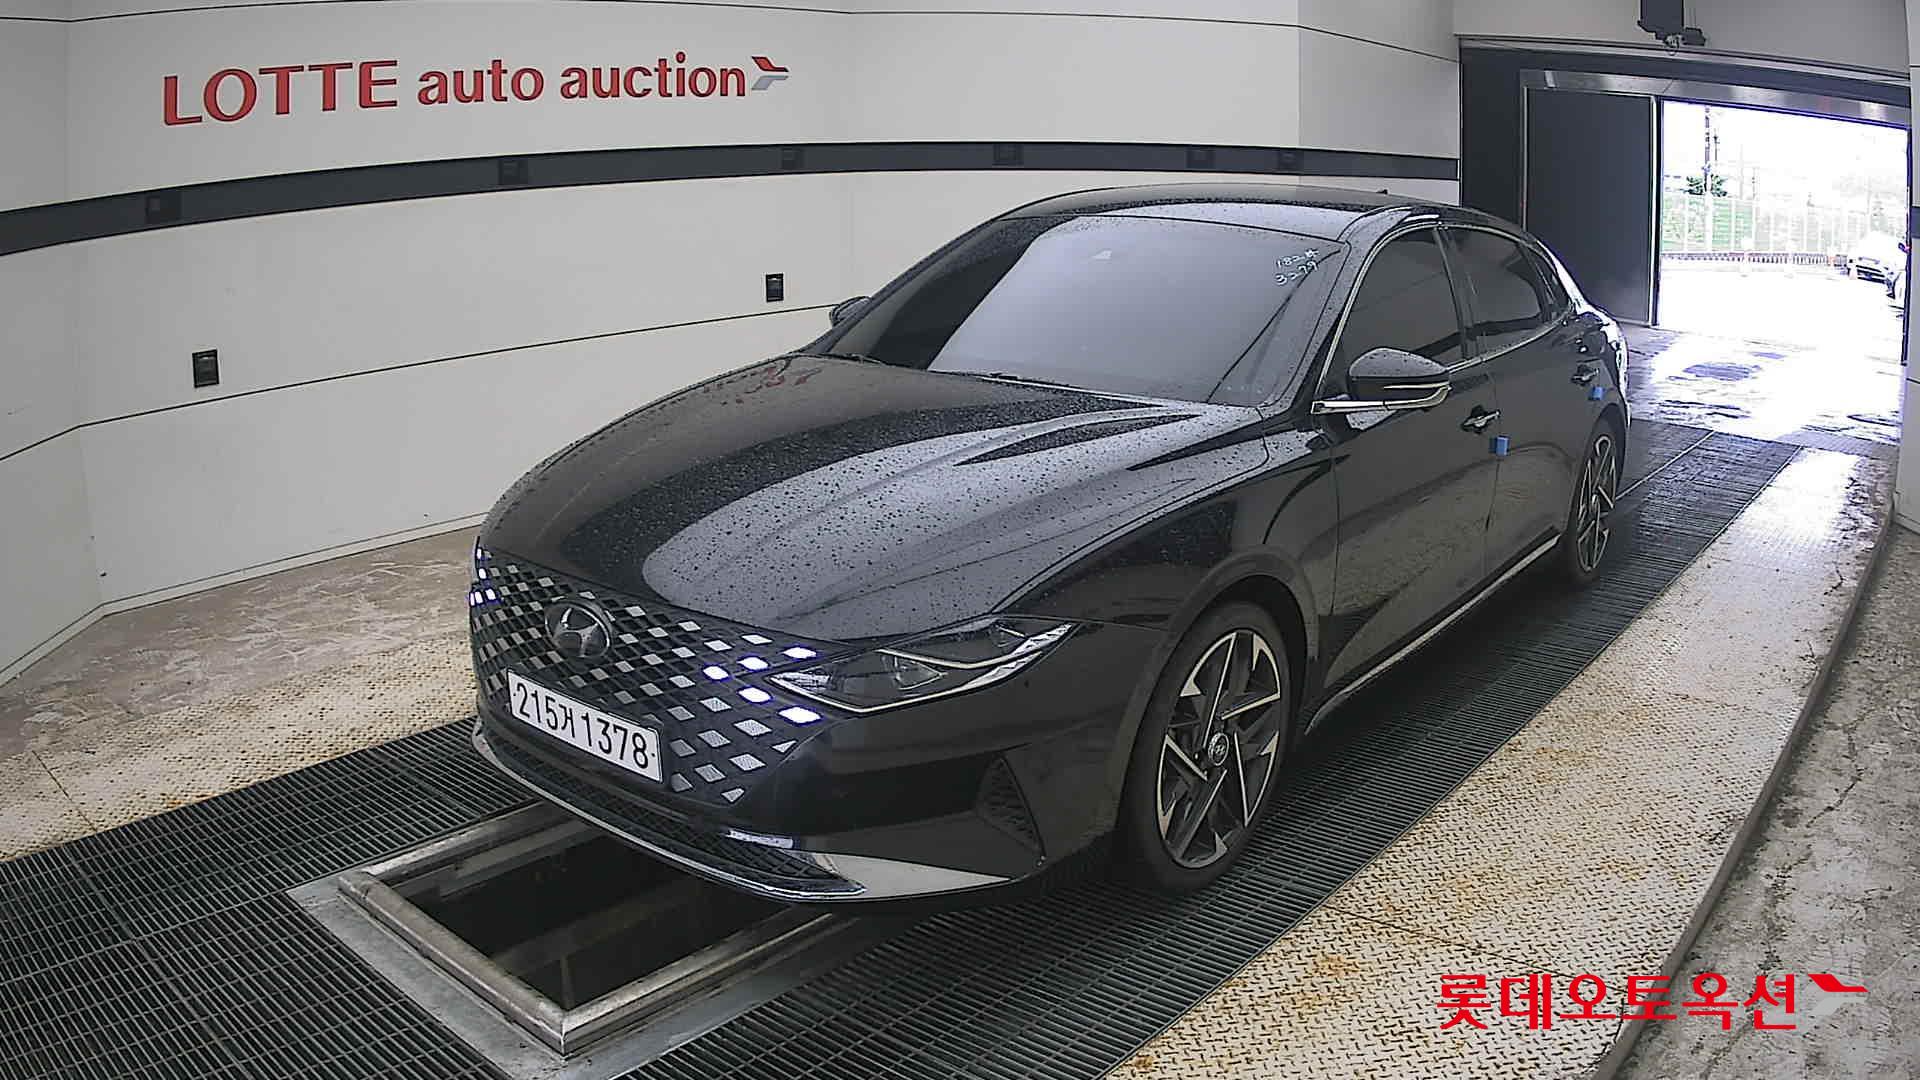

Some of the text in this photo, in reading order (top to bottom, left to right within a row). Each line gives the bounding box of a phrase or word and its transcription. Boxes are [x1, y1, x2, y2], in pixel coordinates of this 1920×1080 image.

[163, 51, 746, 126] LOTTE auto auction
